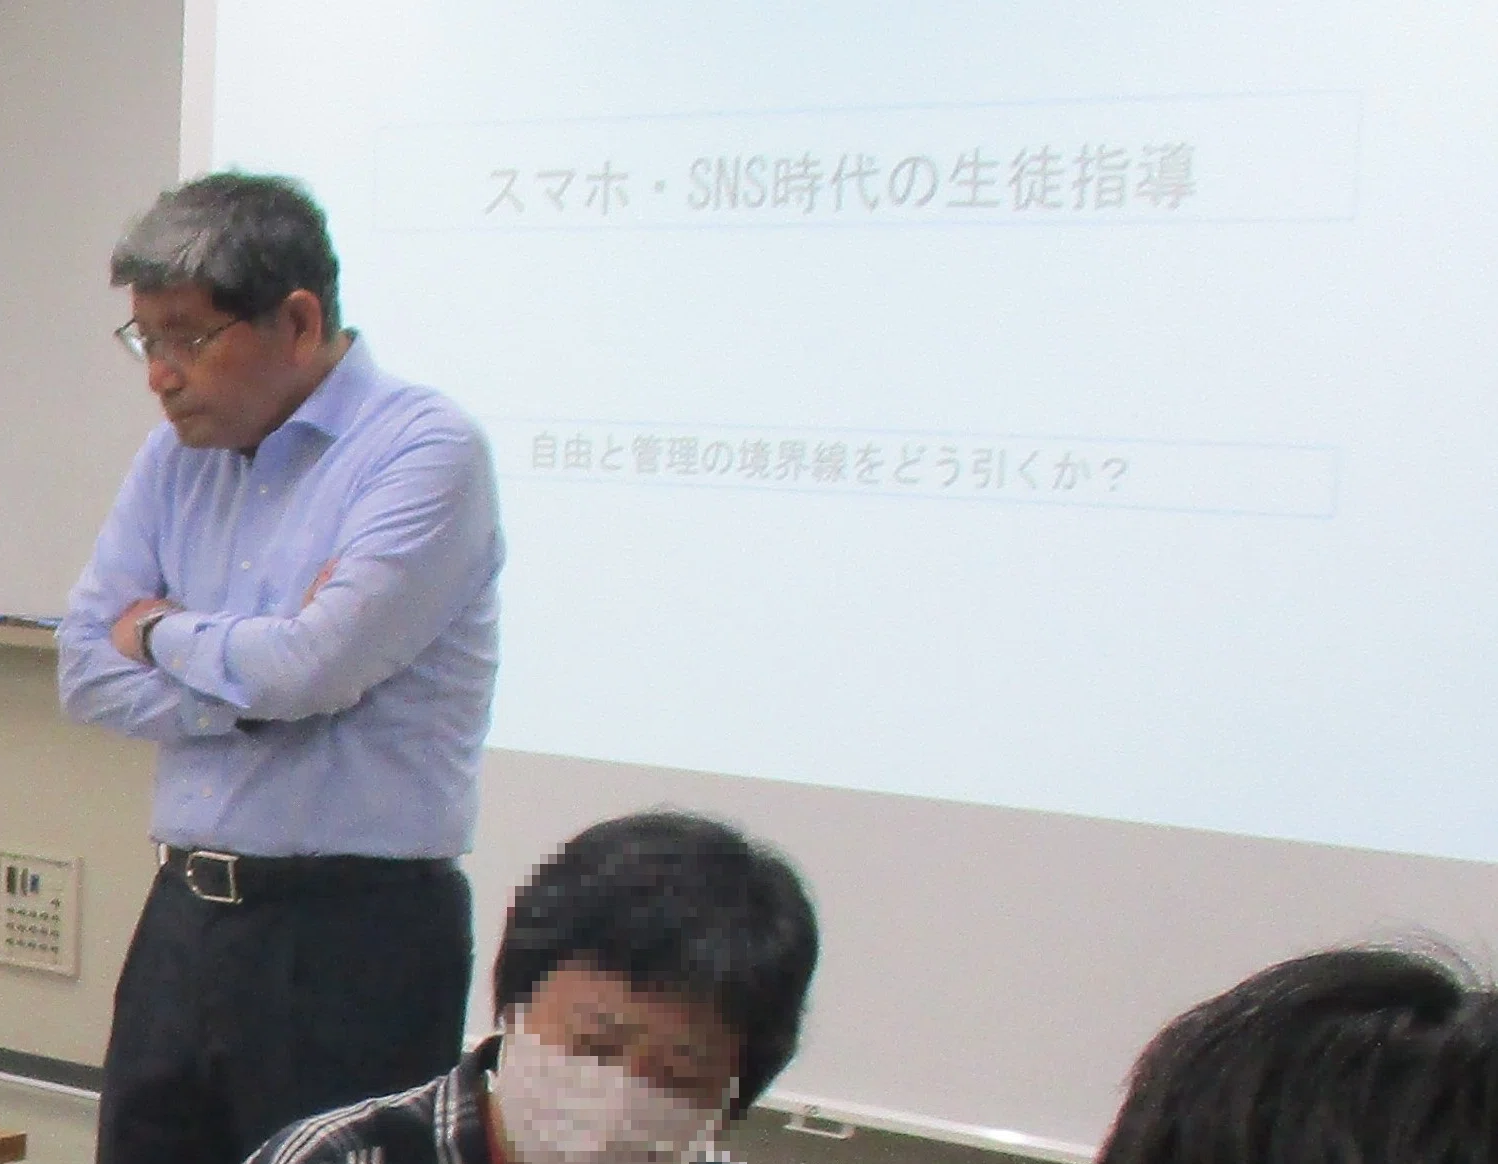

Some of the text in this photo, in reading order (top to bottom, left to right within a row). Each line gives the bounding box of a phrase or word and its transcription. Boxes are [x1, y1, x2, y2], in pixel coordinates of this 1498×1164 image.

[483, 140, 1198, 217] スマホ・SNS時代の生徒指導
[529, 430, 1130, 493] 自由と管理の境界線をどう引くか？
